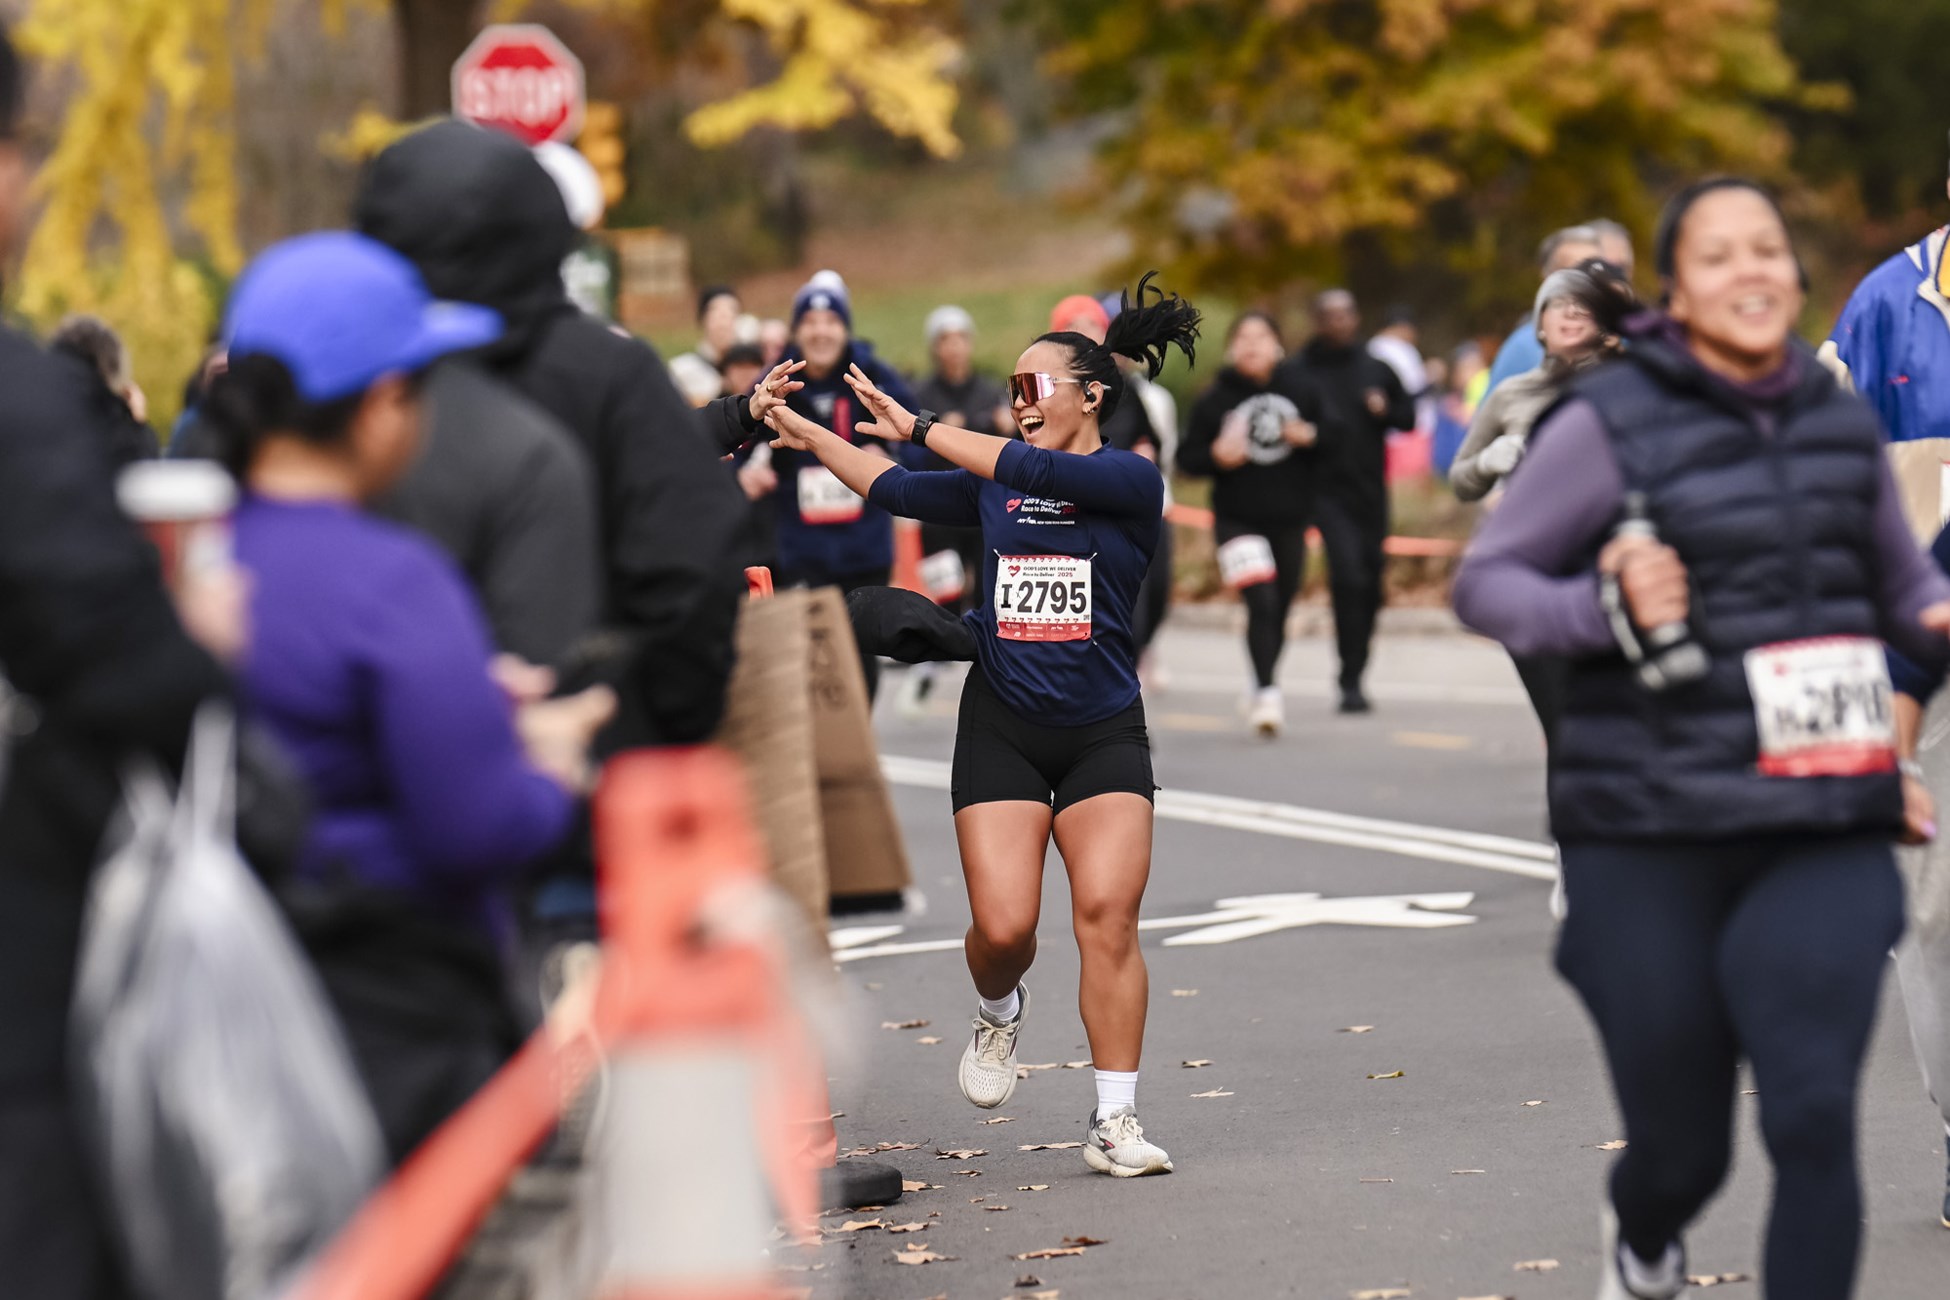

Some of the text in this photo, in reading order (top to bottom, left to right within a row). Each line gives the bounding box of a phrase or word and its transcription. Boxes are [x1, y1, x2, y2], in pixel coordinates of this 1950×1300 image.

[463, 66, 572, 123] STOP
[1040, 505, 1062, 515] Deliver
[1001, 580, 1087, 614] I 2795
